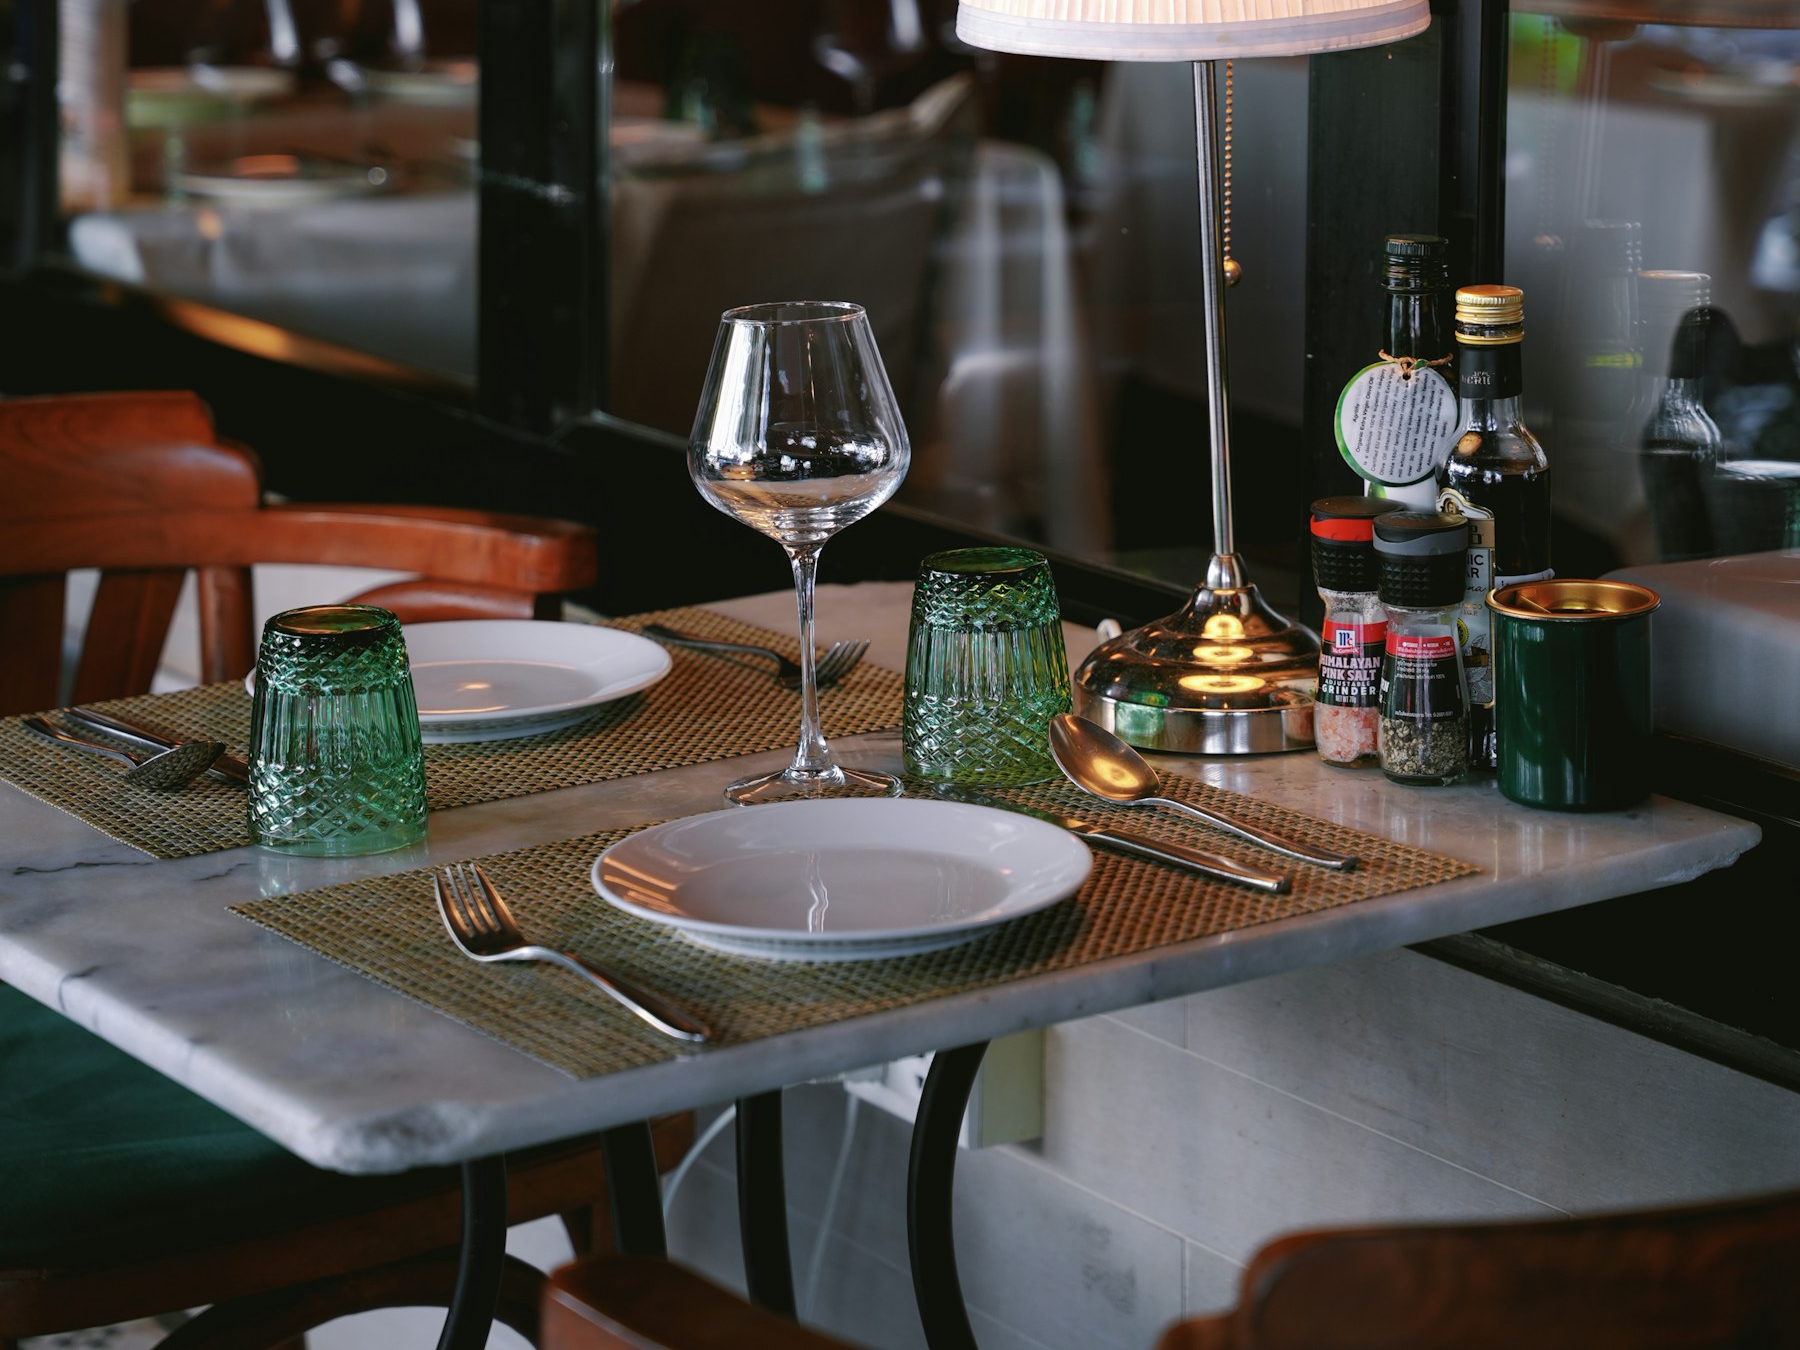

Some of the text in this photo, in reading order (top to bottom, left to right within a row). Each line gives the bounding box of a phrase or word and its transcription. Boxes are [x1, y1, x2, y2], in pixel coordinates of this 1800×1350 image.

[1355, 431, 1364, 452] Organic
[1362, 399, 1370, 415] Virgin
[1320, 654, 1380, 669] HIMALAYAN
[1321, 666, 1377, 681] PINK SALT
[1321, 683, 1376, 696] GRINDER
[1325, 679, 1370, 687] ADJUSTABLE
